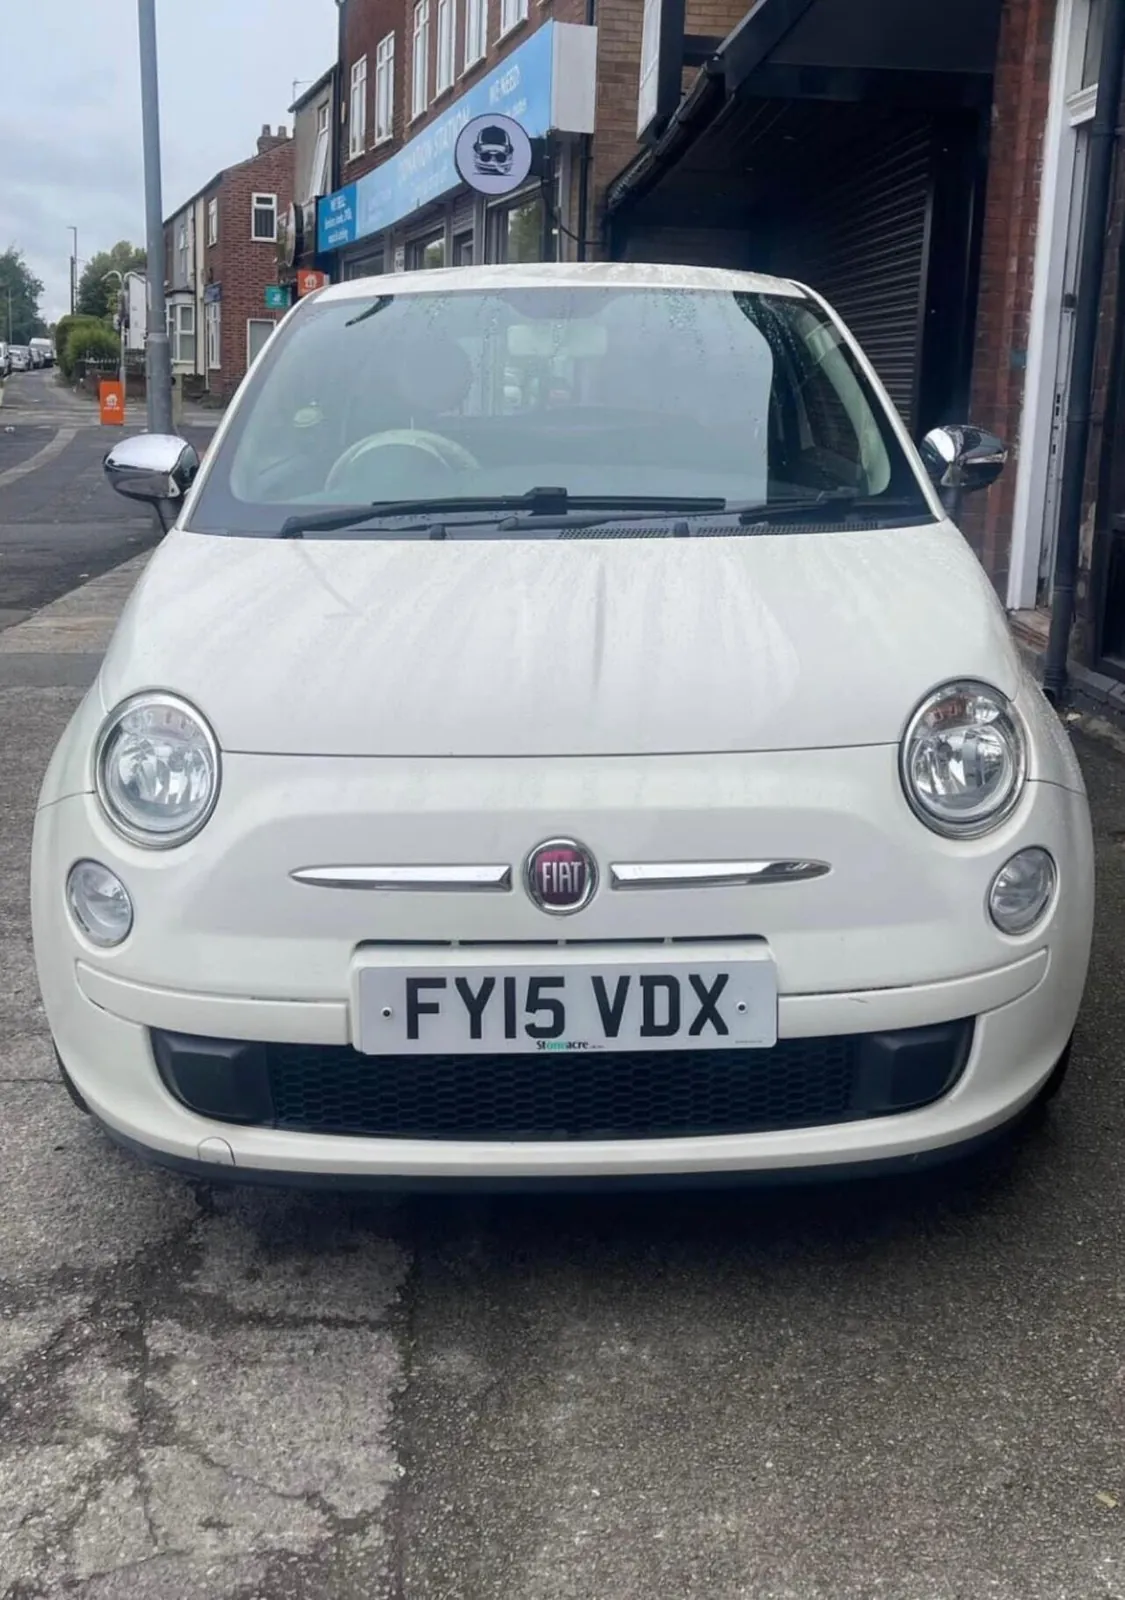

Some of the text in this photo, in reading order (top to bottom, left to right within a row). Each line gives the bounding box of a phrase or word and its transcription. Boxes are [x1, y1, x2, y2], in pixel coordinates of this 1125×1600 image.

[542, 862, 582, 893] FIAT
[405, 973, 730, 1040] FY15 VDX
